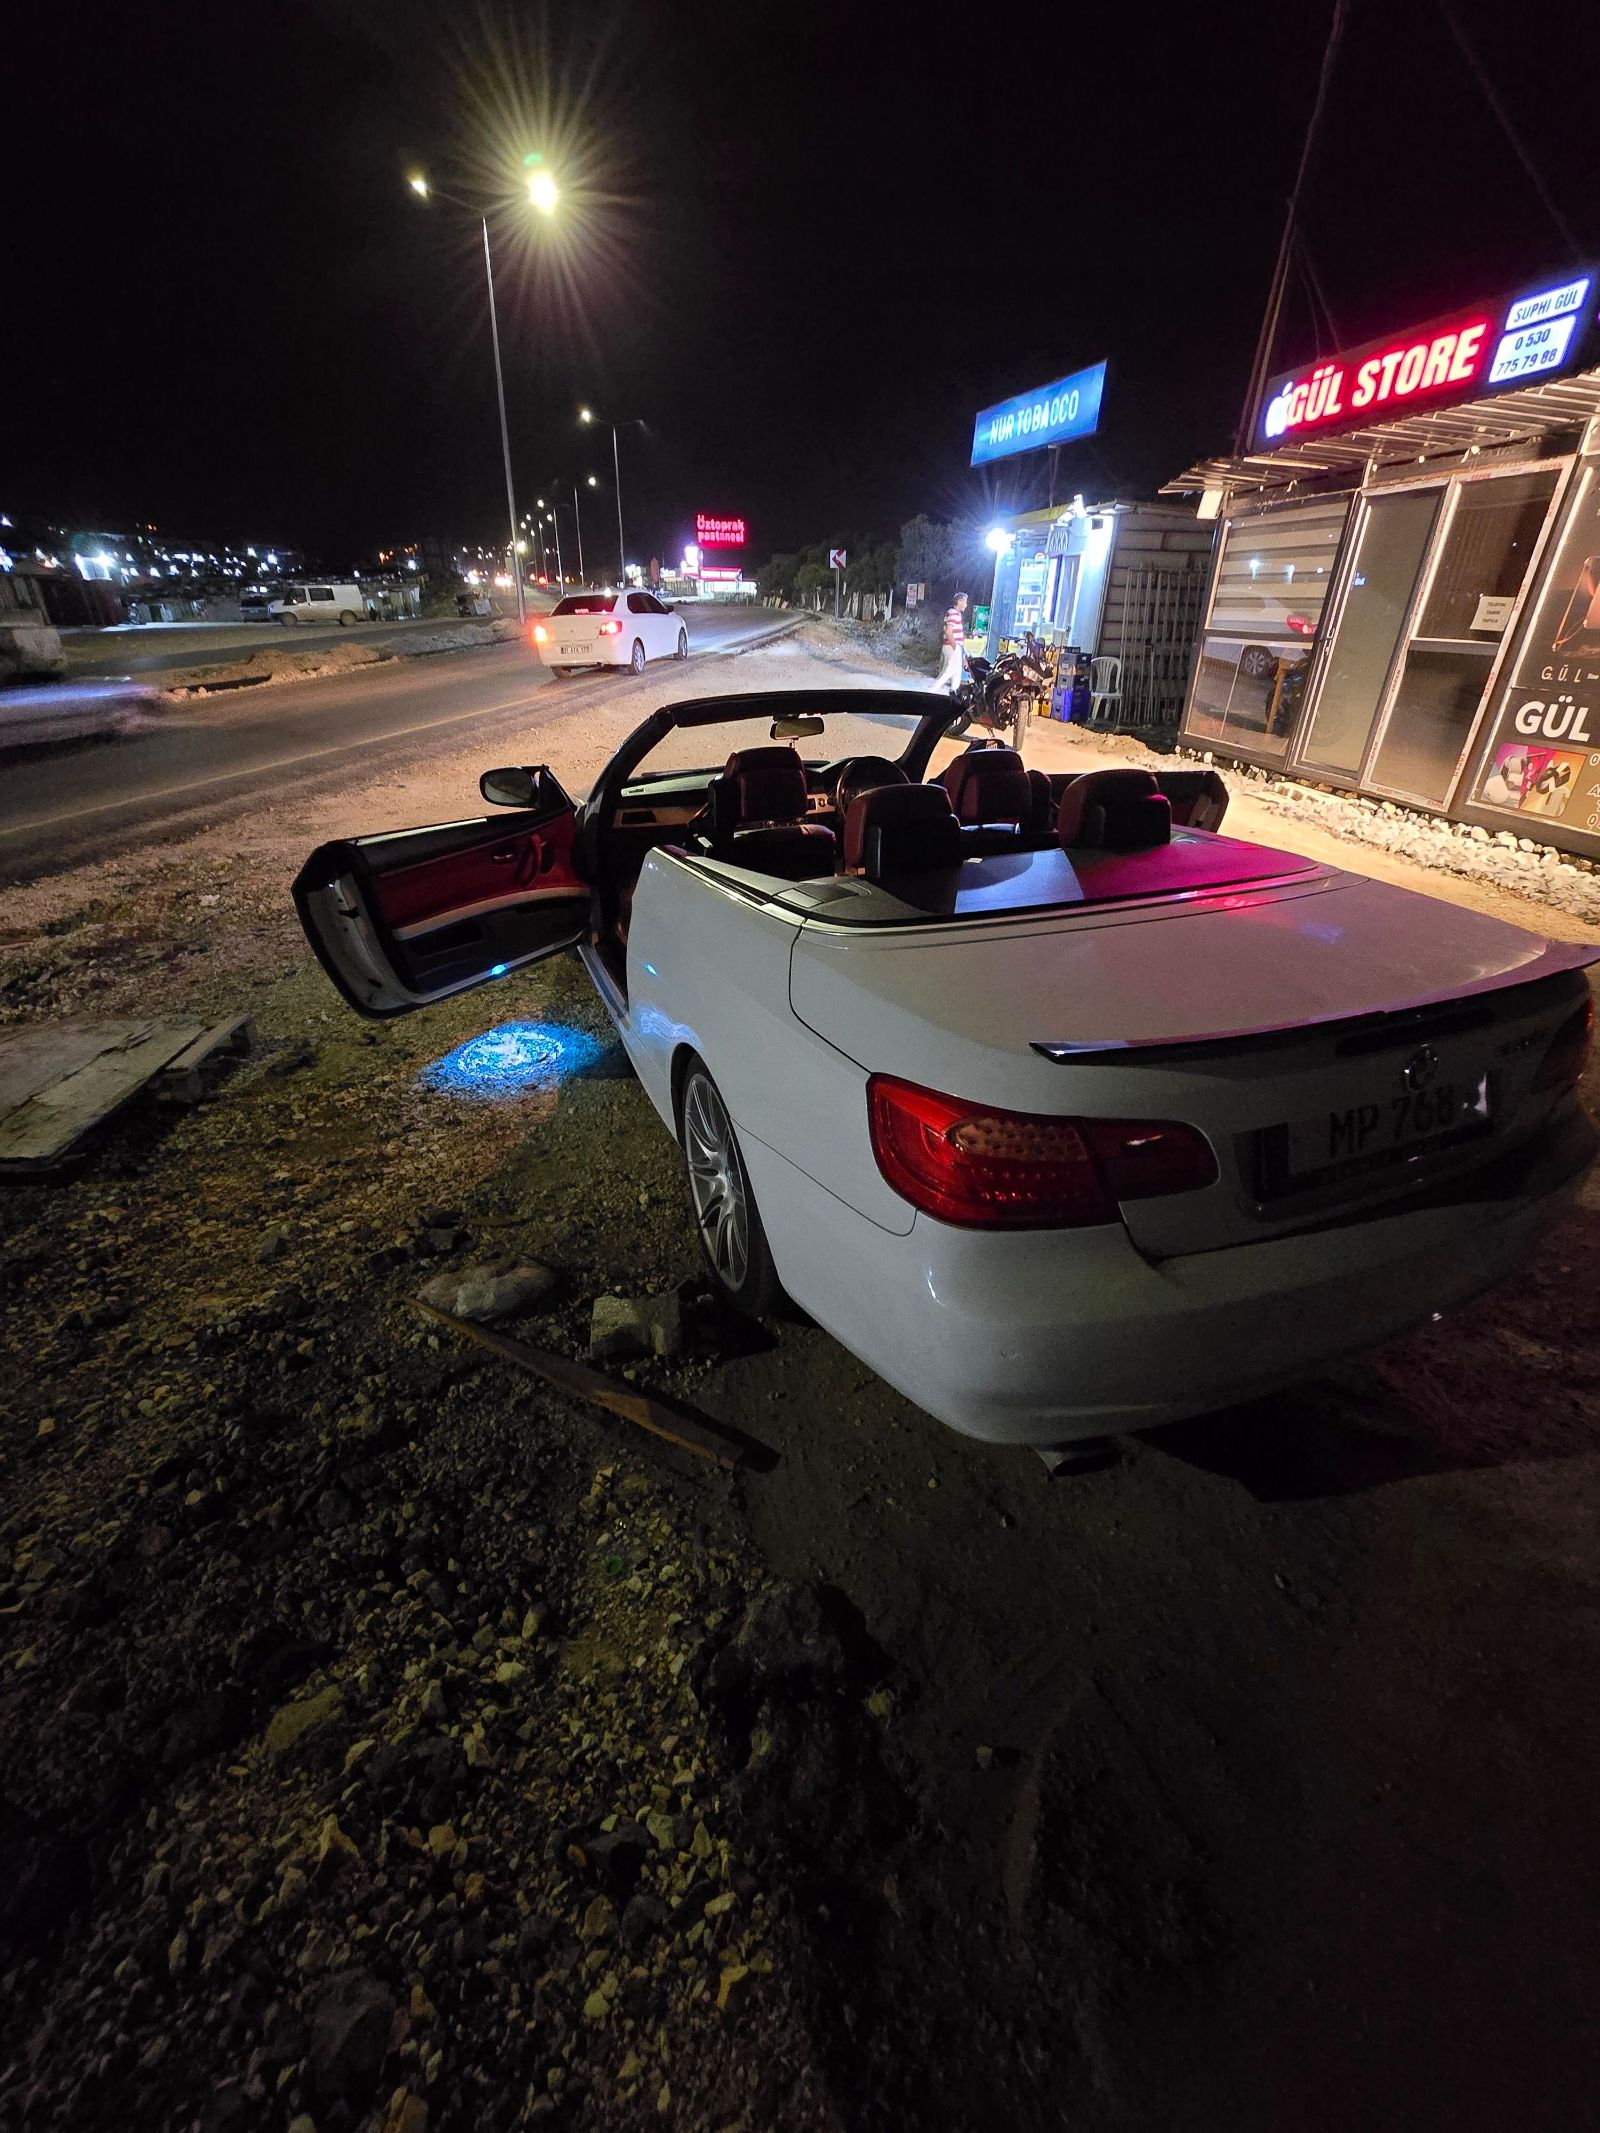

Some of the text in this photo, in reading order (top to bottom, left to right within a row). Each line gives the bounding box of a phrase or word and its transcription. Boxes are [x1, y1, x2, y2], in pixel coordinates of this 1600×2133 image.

[1513, 287, 1578, 323] SUPHI GÜL
[1526, 328, 1551, 348] 530
[1286, 323, 1486, 426] GÜL STORE
[1497, 358, 1519, 376] 775
[1521, 353, 1538, 370] 79
[989, 389, 1080, 446] NUR TOBACCO
[1514, 695, 1591, 742] GÜL
[1330, 1103, 1379, 1158] MP
